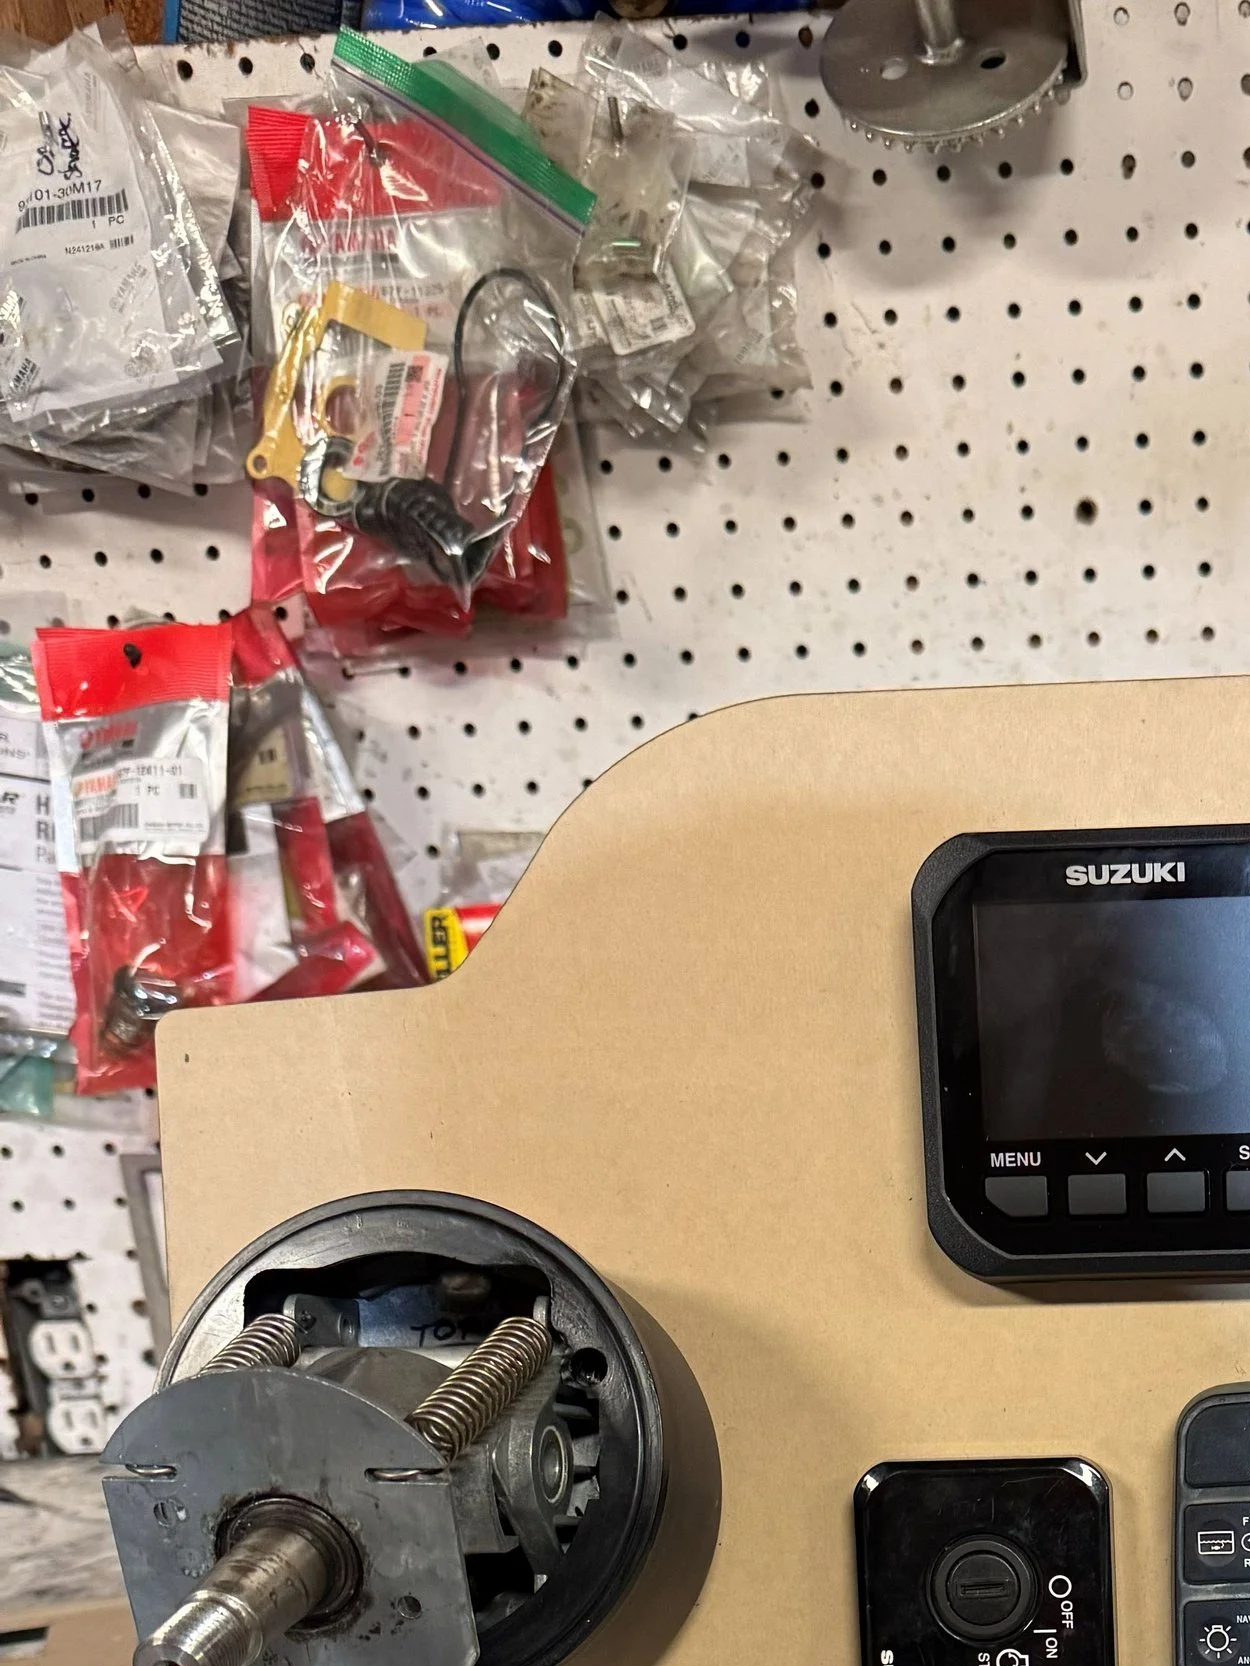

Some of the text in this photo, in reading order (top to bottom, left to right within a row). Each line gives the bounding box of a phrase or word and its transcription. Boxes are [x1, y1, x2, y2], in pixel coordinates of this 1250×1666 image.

[1065, 861, 1186, 886] SUZUKI
[990, 1151, 1042, 1168] MENU
[1242, 1516, 1250, 1527] F
[1060, 1600, 1074, 1630] OFF
[1046, 1637, 1058, 1659] ON
